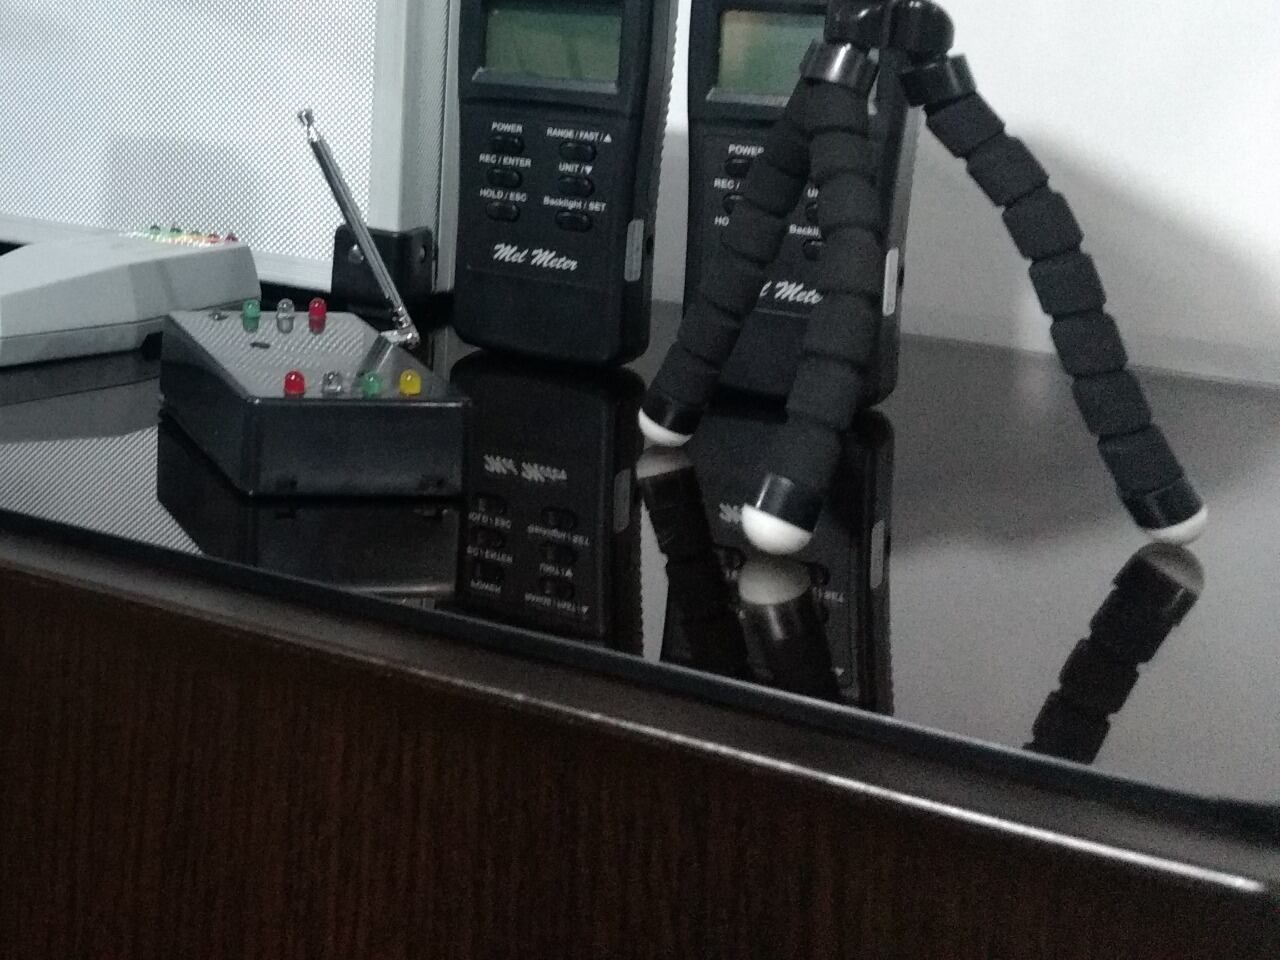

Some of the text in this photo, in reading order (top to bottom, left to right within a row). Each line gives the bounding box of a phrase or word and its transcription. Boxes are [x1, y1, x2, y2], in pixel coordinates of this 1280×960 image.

[491, 121, 523, 134] POWER
[546, 126, 574, 139] RANGE
[579, 130, 600, 141] FAST
[479, 152, 498, 165] REC
[502, 156, 532, 169] ENTER
[558, 162, 580, 174] UNIT
[714, 177, 735, 190] REC
[479, 187, 504, 200] HOLD
[508, 191, 528, 203] ESC
[542, 194, 583, 211] Backlight
[587, 200, 608, 213] SET
[492, 242, 579, 271] Mel Meter
[774, 280, 824, 305] Mete
